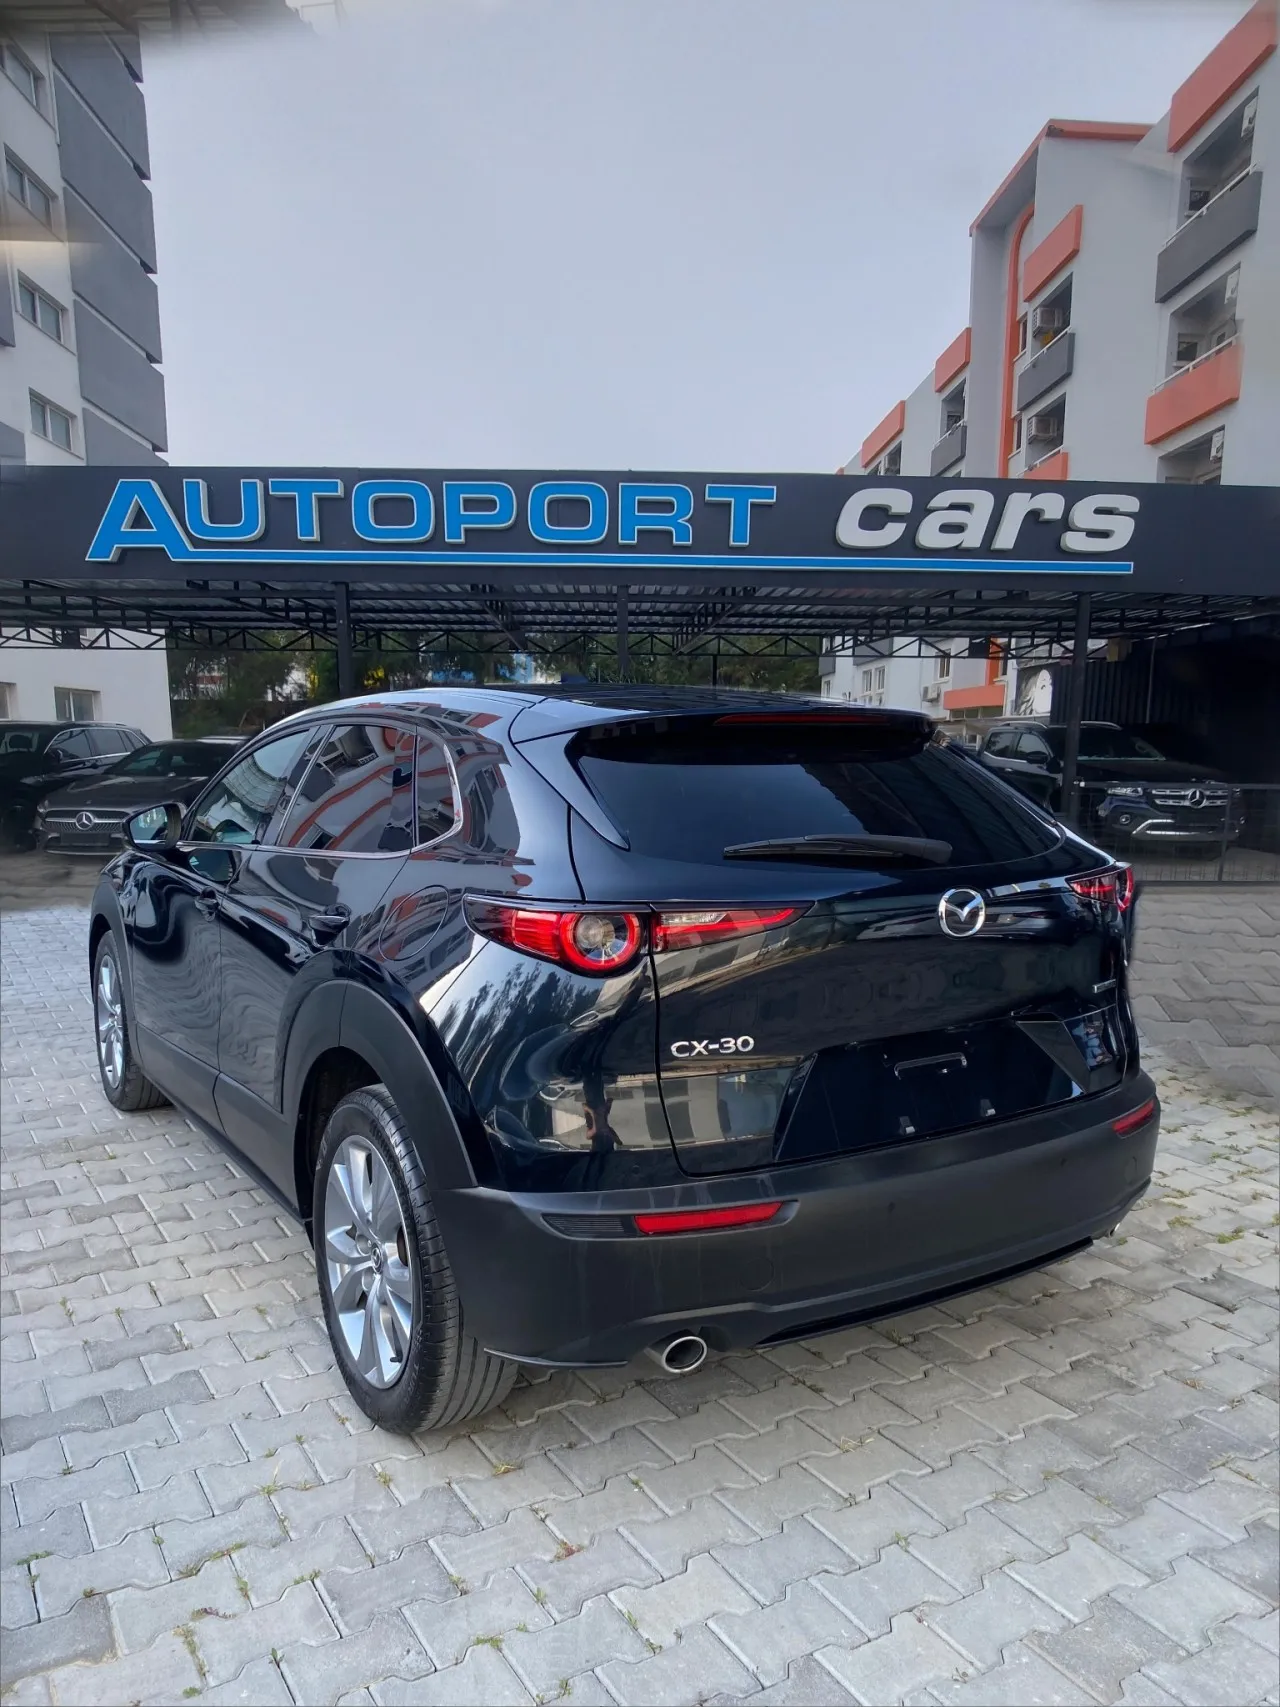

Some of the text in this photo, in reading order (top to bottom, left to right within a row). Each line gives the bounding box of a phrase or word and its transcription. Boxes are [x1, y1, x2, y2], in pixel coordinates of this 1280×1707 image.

[85, 477, 1140, 563] AUTOPORT cars
[670, 1035, 755, 1058] CX-30
